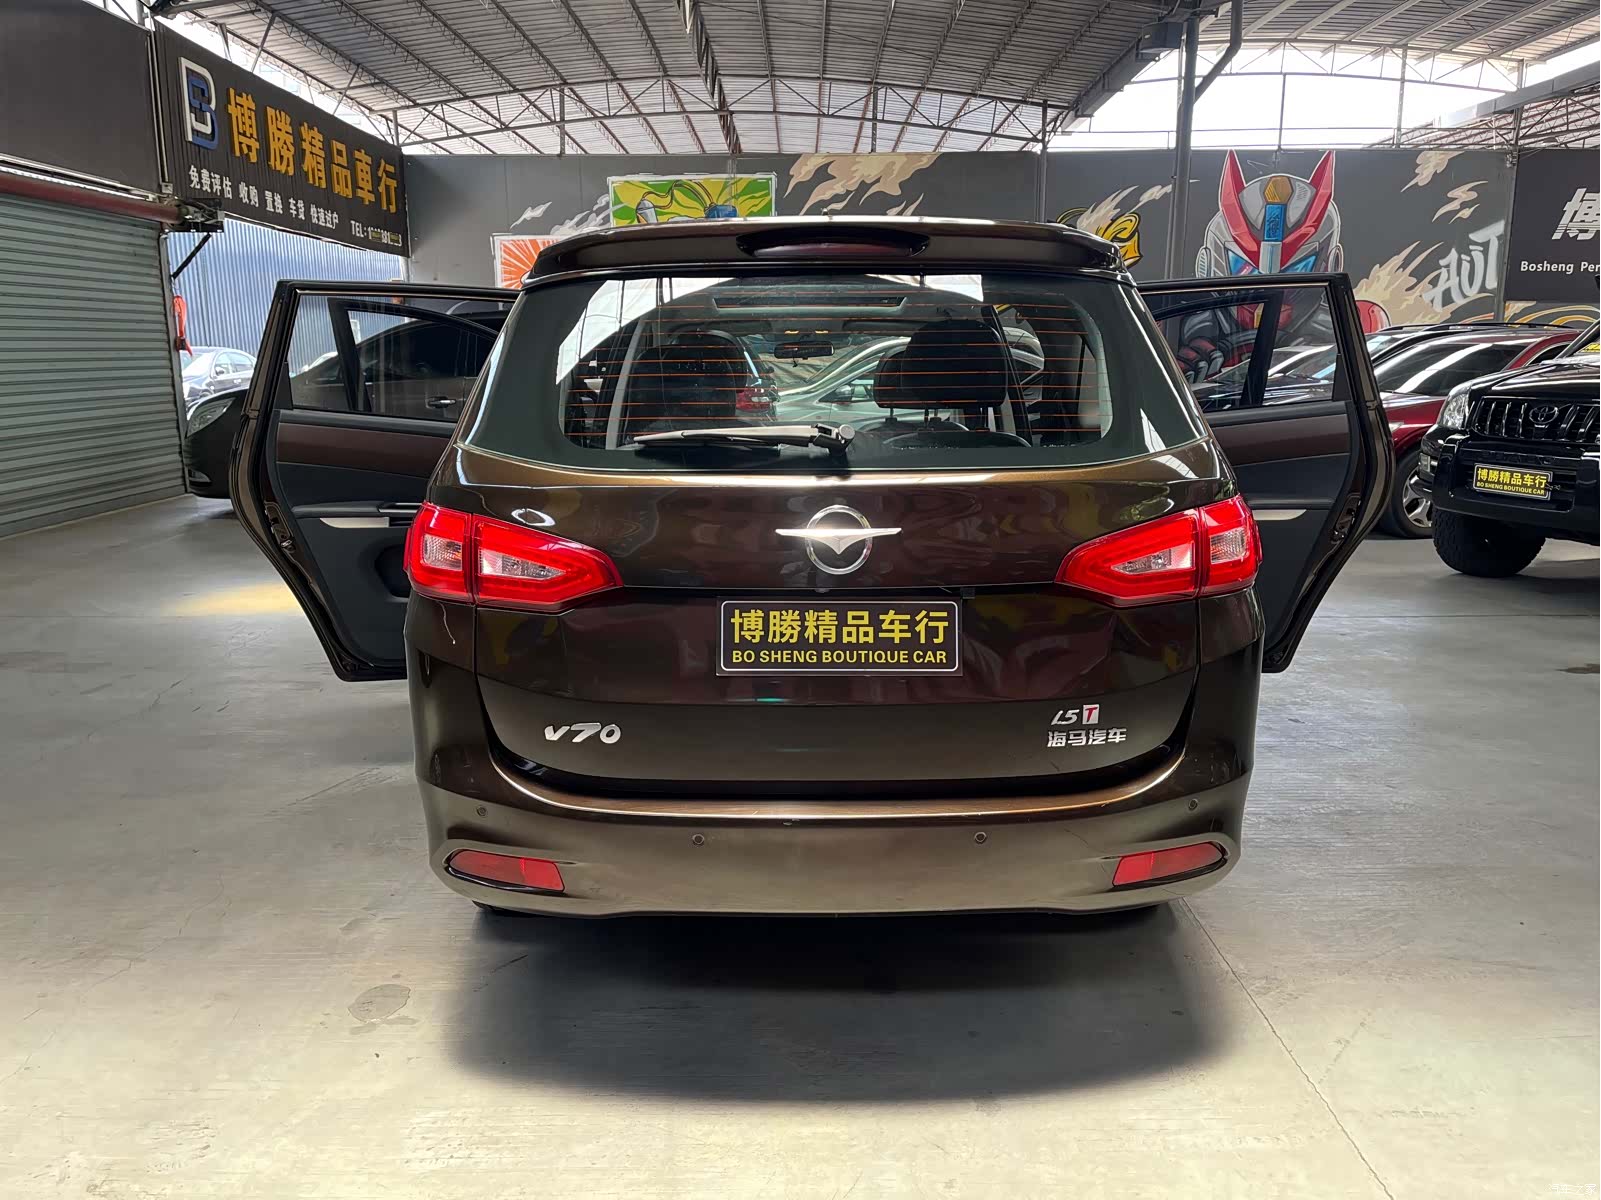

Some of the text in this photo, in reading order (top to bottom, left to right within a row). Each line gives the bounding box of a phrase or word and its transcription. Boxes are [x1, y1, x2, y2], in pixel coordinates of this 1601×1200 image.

[227, 88, 398, 213] 博勝精品車行
[189, 165, 232, 199] 免费评估
[239, 182, 259, 207] 收购
[264, 190, 283, 214] 置换
[310, 204, 339, 229] 快速过户
[1520, 260, 1574, 274] Bosheng
[1477, 468, 1547, 488] 博勝精品车行
[1504, 485, 1532, 494] BOUTIQUE
[731, 609, 949, 644] 博勝精品车行
[732, 650, 947, 663] BO SHENG BOUTIQUE CAR
[1047, 727, 1127, 747] 海马汽车
